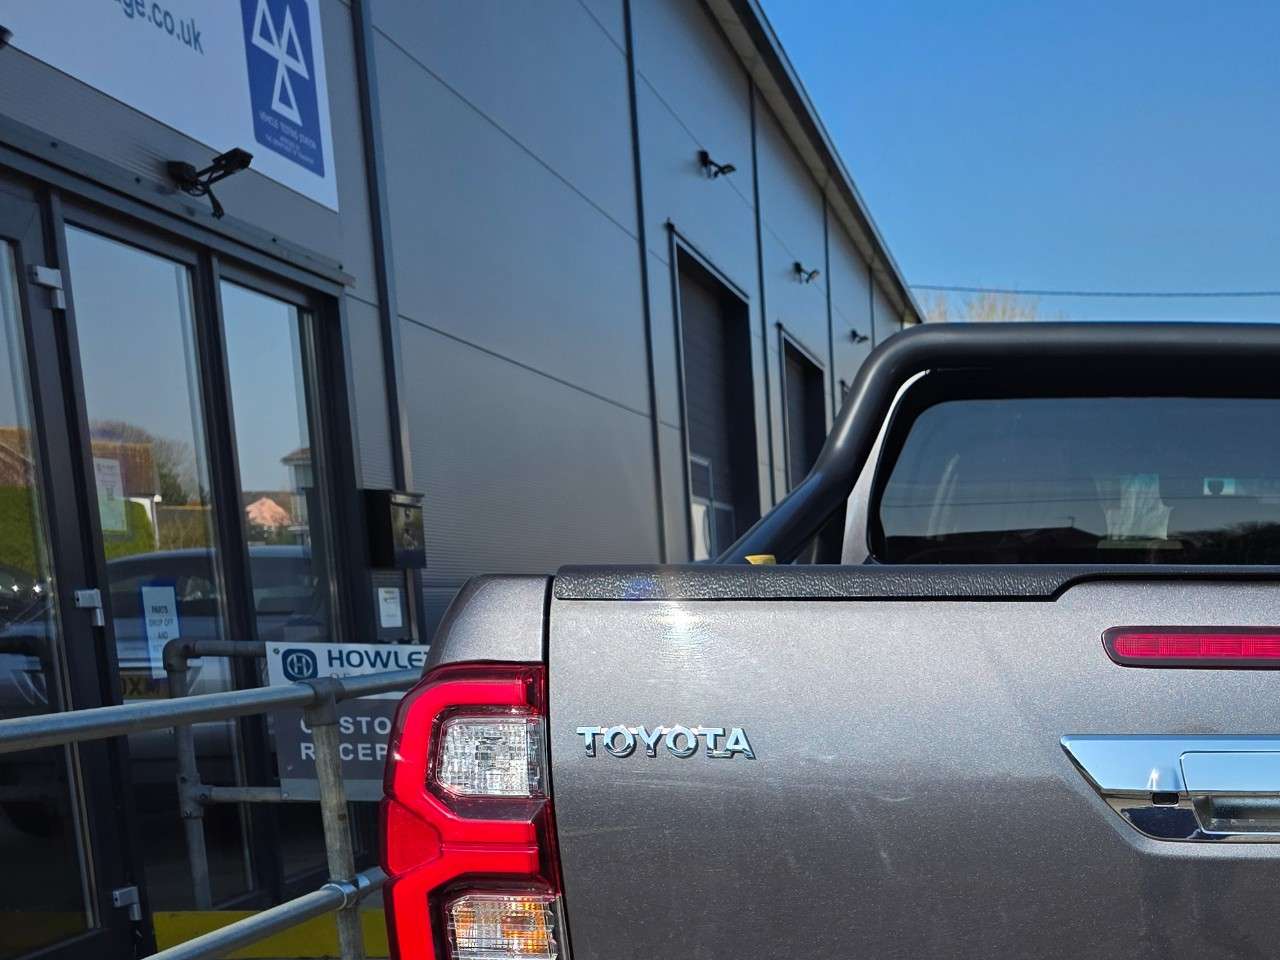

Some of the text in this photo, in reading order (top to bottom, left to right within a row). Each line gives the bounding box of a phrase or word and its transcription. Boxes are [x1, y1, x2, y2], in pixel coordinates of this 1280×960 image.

[114, 0, 204, 55] ge.co.uk
[327, 649, 428, 670] HOWLE
[300, 742, 388, 761] RCEP
[576, 724, 757, 760] TOYOTA
